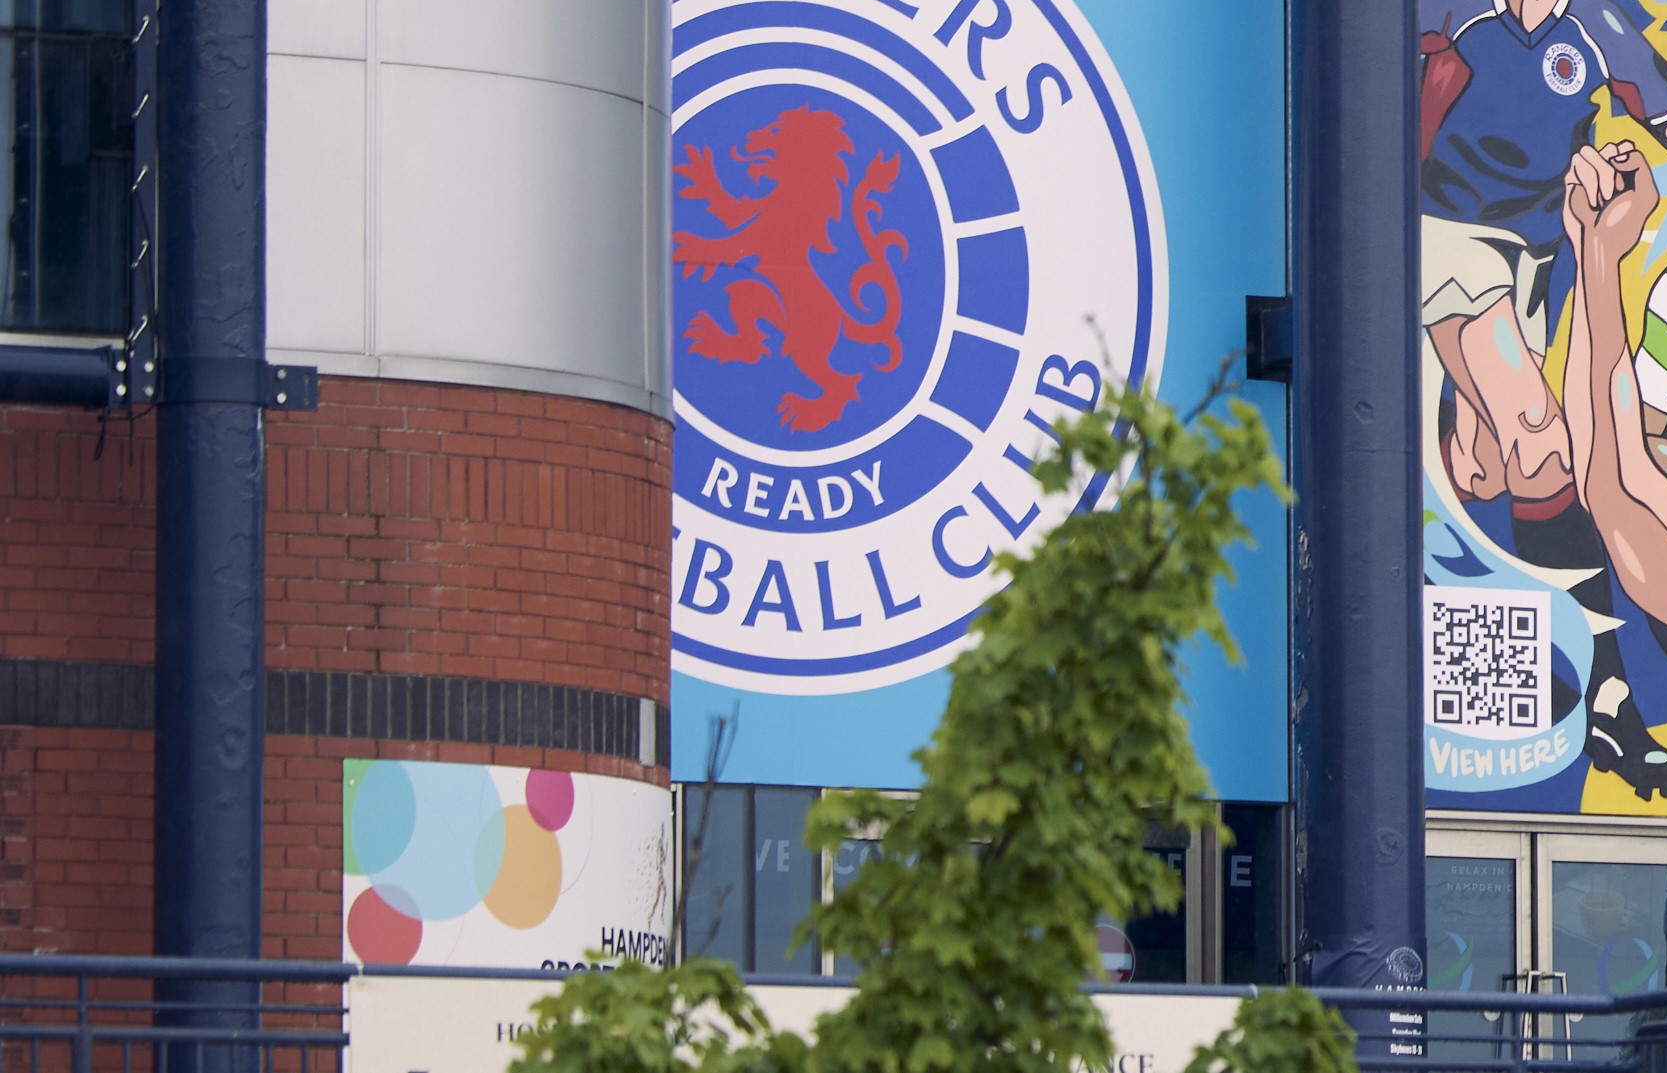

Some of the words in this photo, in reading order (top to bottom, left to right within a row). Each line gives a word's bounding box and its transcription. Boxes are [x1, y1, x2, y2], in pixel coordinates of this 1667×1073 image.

[702, 457, 884, 521] READY
[673, 525, 921, 632] BALL
[1429, 737, 1493, 778] VIEW
[1501, 728, 1570, 776] HERE
